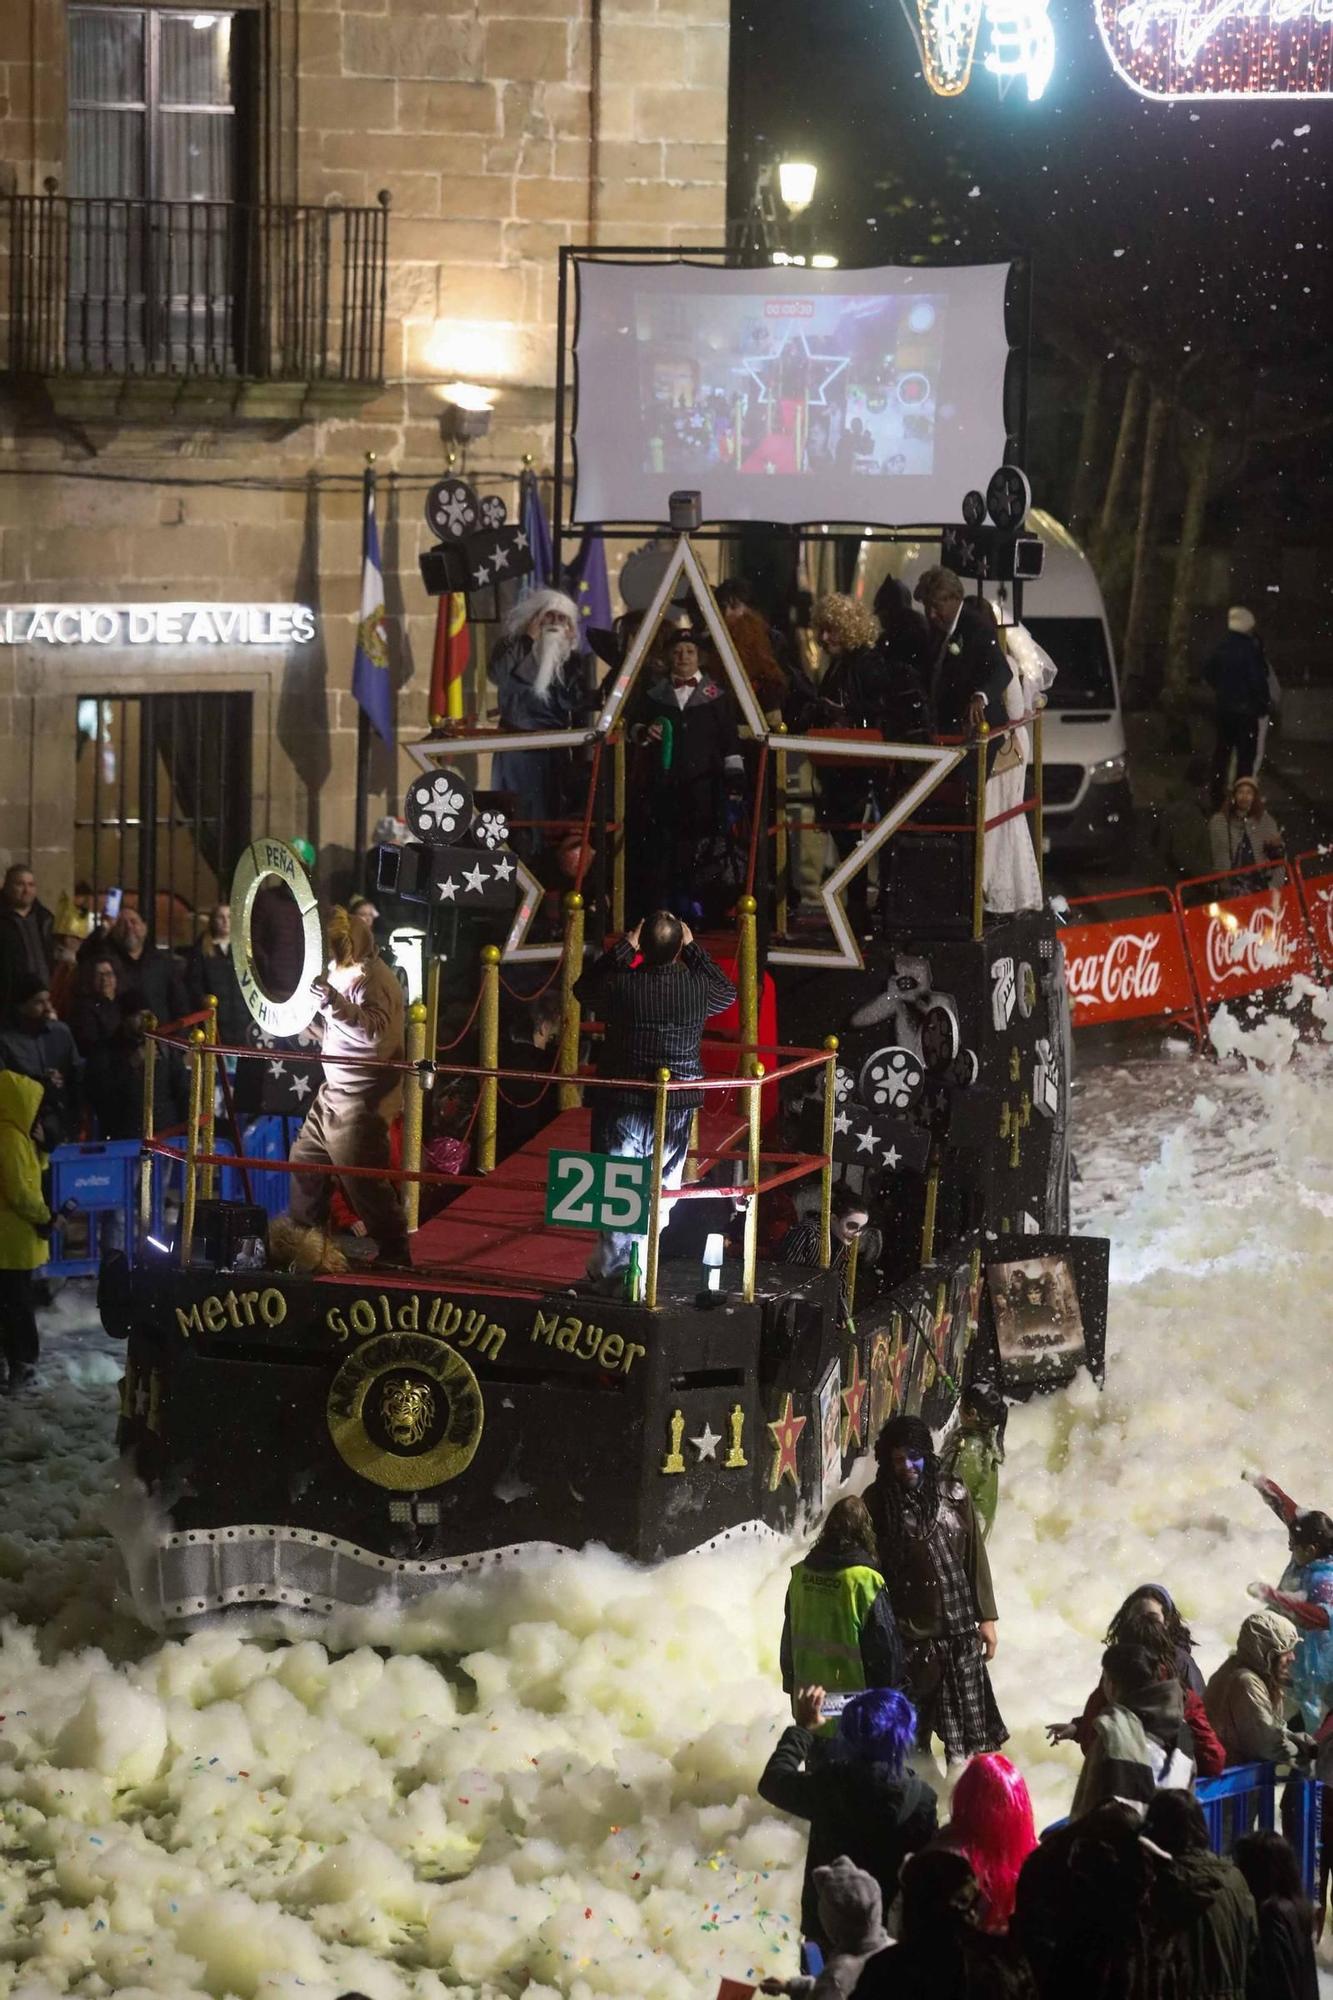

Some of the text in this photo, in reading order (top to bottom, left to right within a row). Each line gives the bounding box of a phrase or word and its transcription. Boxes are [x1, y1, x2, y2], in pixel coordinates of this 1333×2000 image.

[129, 607, 185, 643] DE
[185, 607, 315, 643] AVILES
[266, 845, 295, 879] PEÑA
[552, 1157, 642, 1227] 25
[175, 1287, 288, 1338] Metro
[530, 1309, 646, 1375] Mayer
